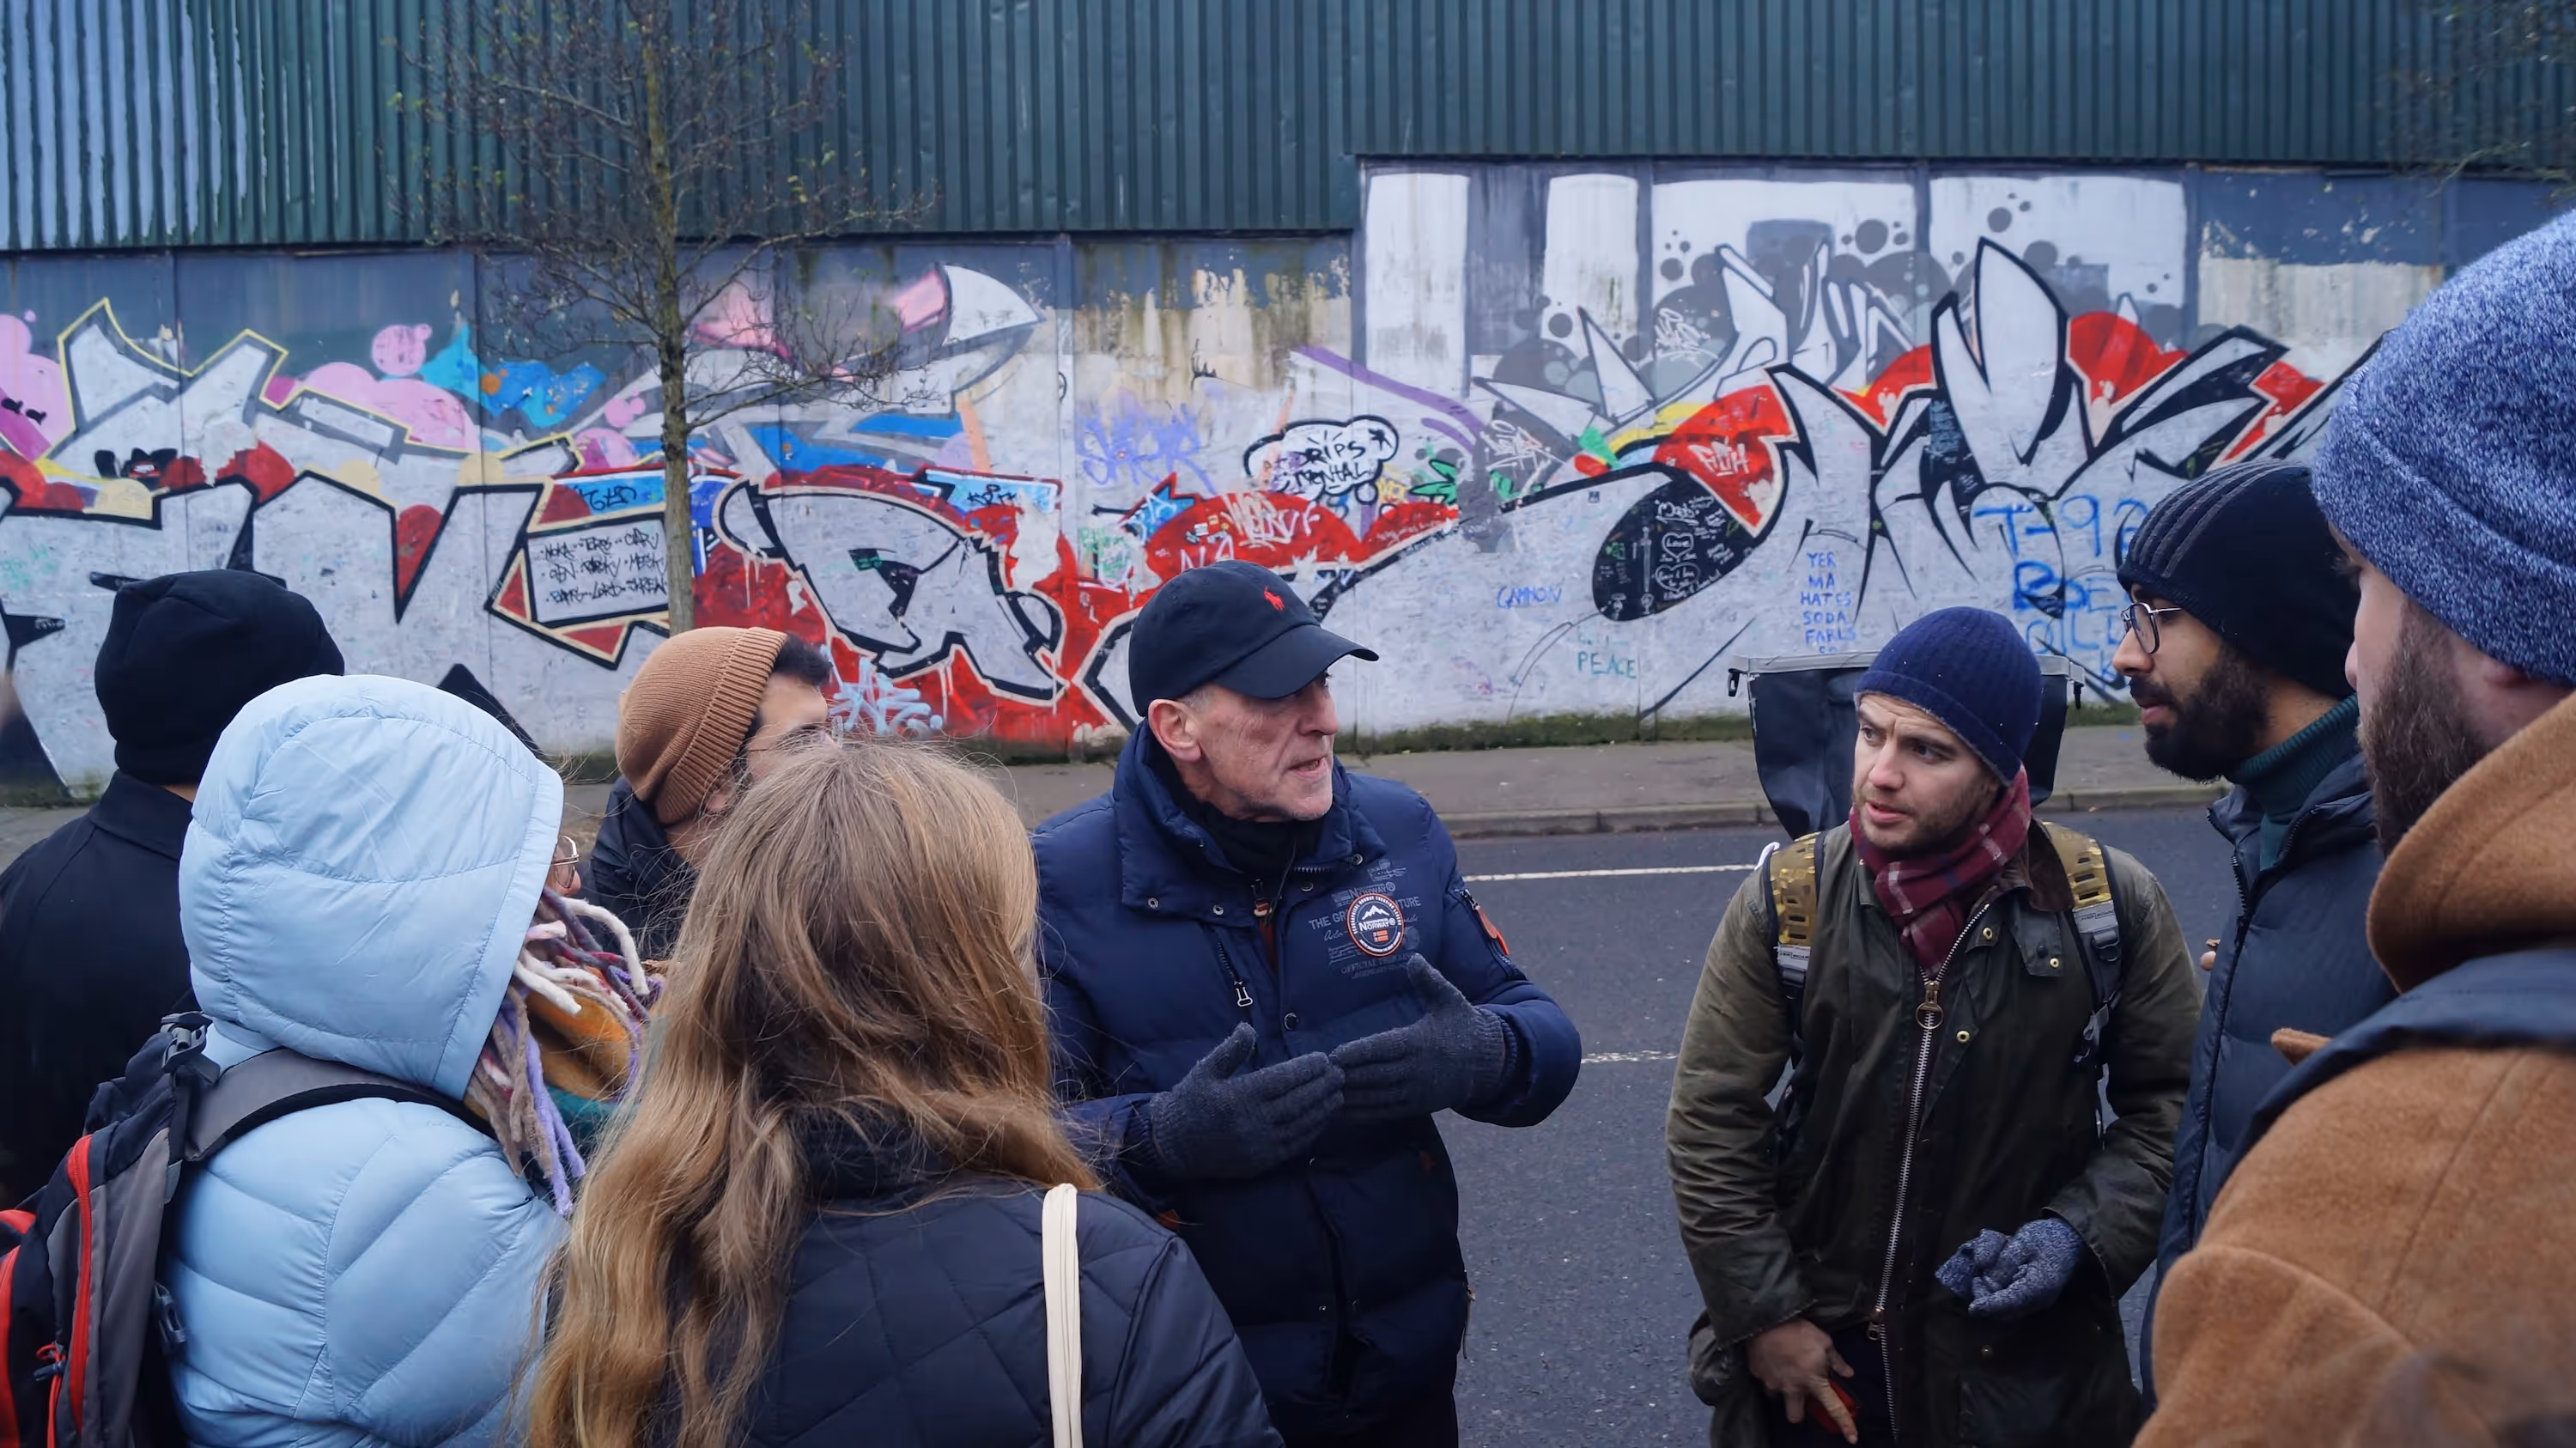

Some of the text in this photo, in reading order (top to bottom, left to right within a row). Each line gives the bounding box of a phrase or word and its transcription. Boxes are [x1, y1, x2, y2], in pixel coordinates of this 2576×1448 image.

[1807, 551, 1837, 568] YER
[1808, 572, 1835, 589] MA
[1800, 591, 1852, 606] HATES
[1802, 611, 1847, 626] SODA
[1577, 651, 1637, 679] PEACE
[1309, 916, 1332, 930] THE
[1333, 910, 1347, 922] GR
